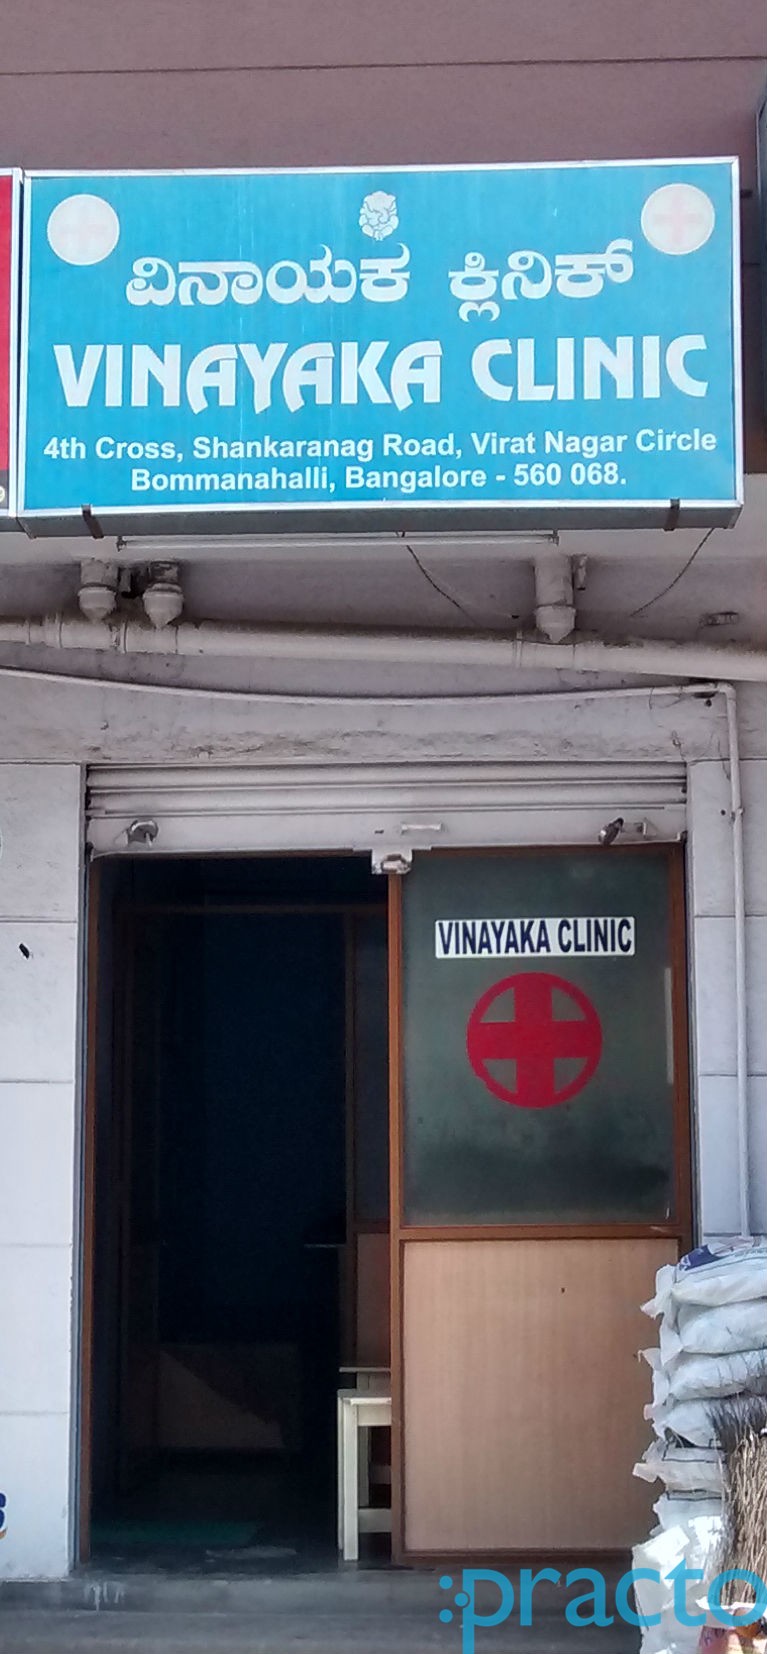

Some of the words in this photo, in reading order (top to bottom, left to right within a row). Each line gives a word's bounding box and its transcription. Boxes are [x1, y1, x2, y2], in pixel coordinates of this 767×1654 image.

[126, 243, 410, 306] ವಿನಾಯಕ
[449, 239, 633, 322] ಕ್ಲಿನಿಕ್
[53, 341, 442, 414] VINAYAKA
[472, 335, 708, 401] CLINIC
[43, 437, 86, 459] 4th
[95, 437, 183, 462] Cross,
[193, 435, 373, 462] Shankaranag
[383, 434, 462, 459] Road,
[471, 431, 535, 455] Virat
[545, 431, 627, 458] Nagar
[635, 429, 716, 451] Circle
[131, 467, 336, 493] Bommanahalli,
[345, 464, 486, 493] Bangalore
[513, 463, 561, 486] 560
[570, 462, 626, 486] 068.
[438, 920, 551, 955] VINAYAKA
[558, 918, 632, 953] CLINIC
